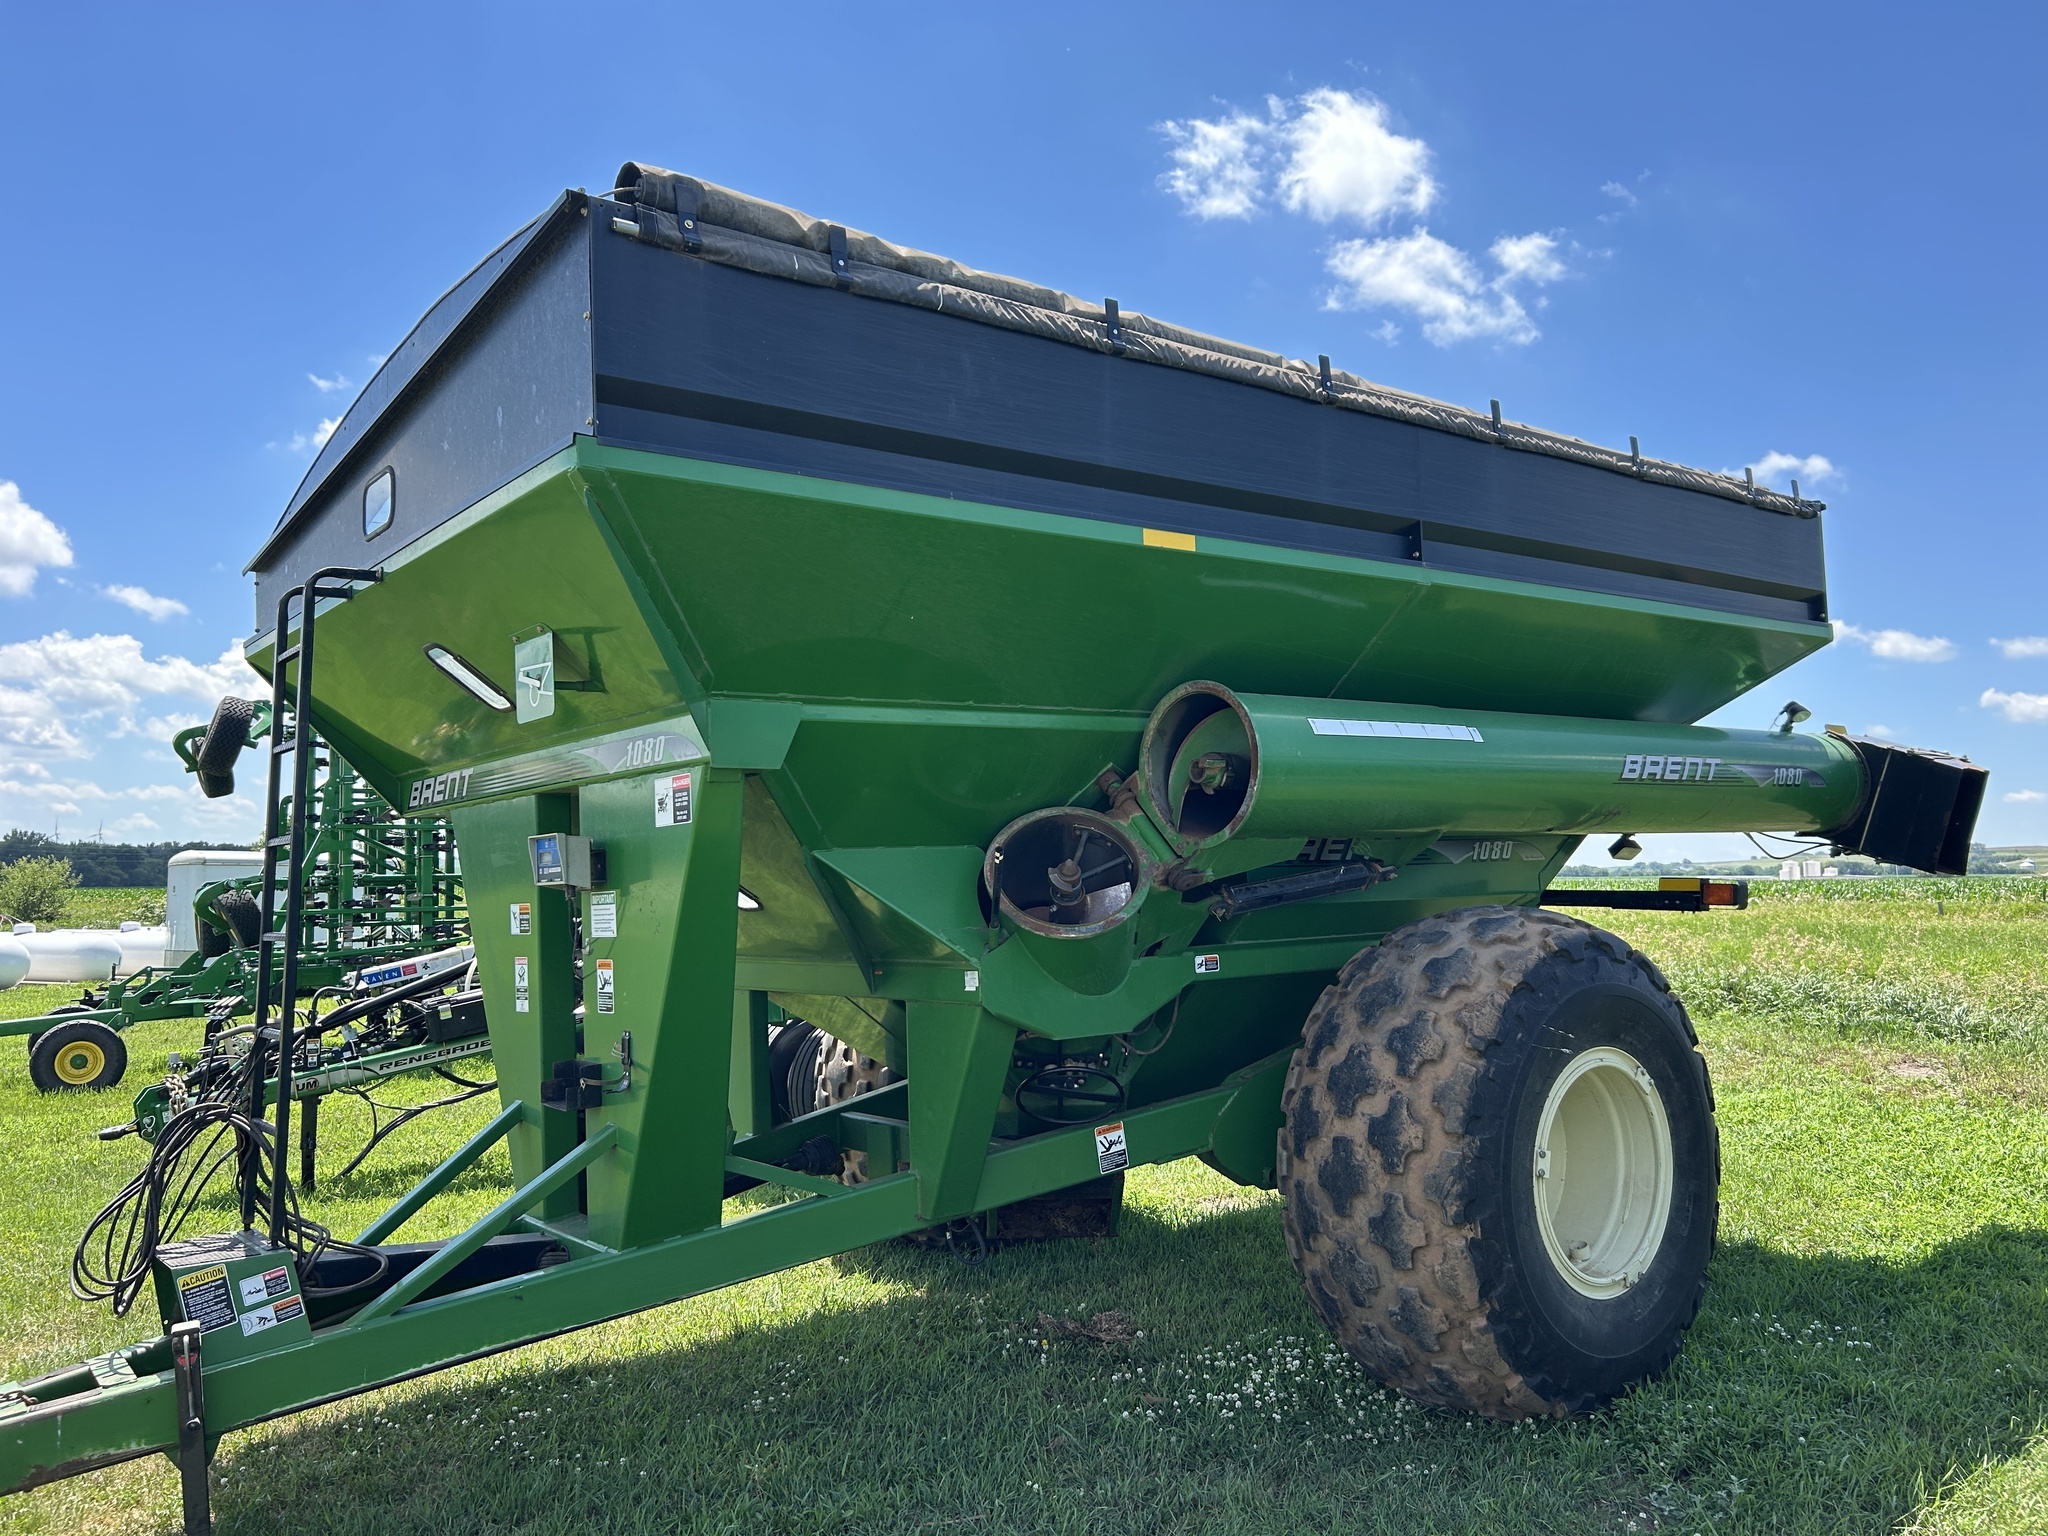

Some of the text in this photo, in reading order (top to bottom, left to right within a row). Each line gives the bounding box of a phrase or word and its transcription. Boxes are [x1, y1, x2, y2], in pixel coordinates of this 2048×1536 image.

[409, 735, 666, 807] BRENT 1080
[1620, 754, 1803, 787] BRENT 1080
[1472, 840, 1514, 860] 1080
[363, 970, 399, 984] RAVEN
[379, 1039, 491, 1071] RENEGADE
[189, 1266, 225, 1286] CAUTION
